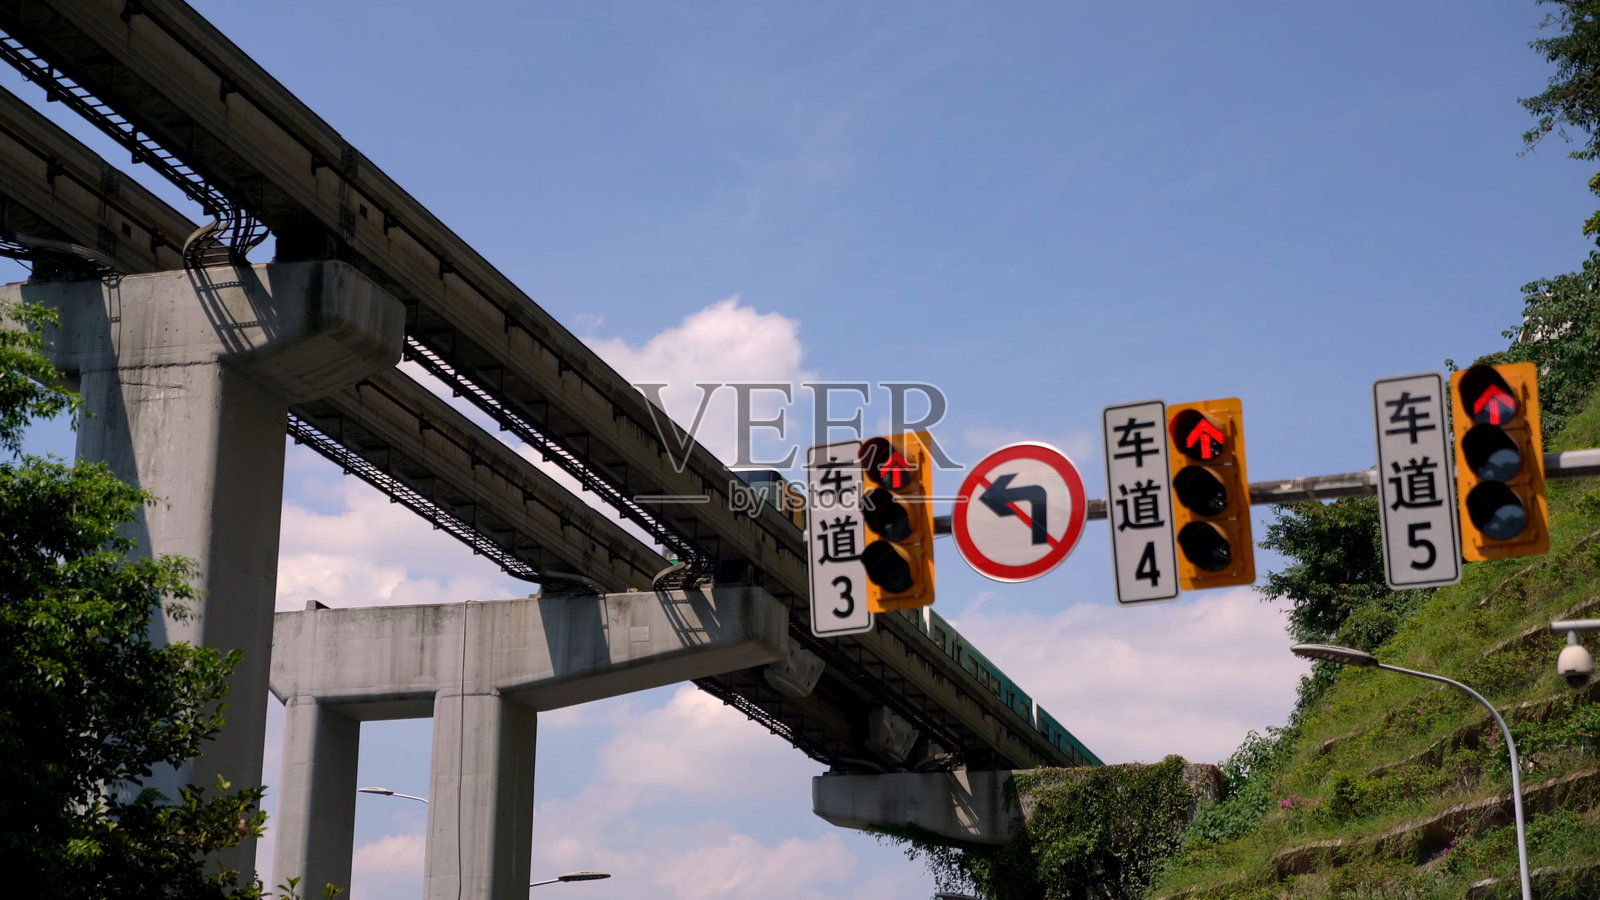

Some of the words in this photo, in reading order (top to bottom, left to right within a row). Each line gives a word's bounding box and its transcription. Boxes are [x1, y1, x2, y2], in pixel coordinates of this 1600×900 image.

[816, 456, 862, 618] 车道3
[1113, 417, 1165, 588] 车道4
[1385, 391, 1443, 570] 车道5
